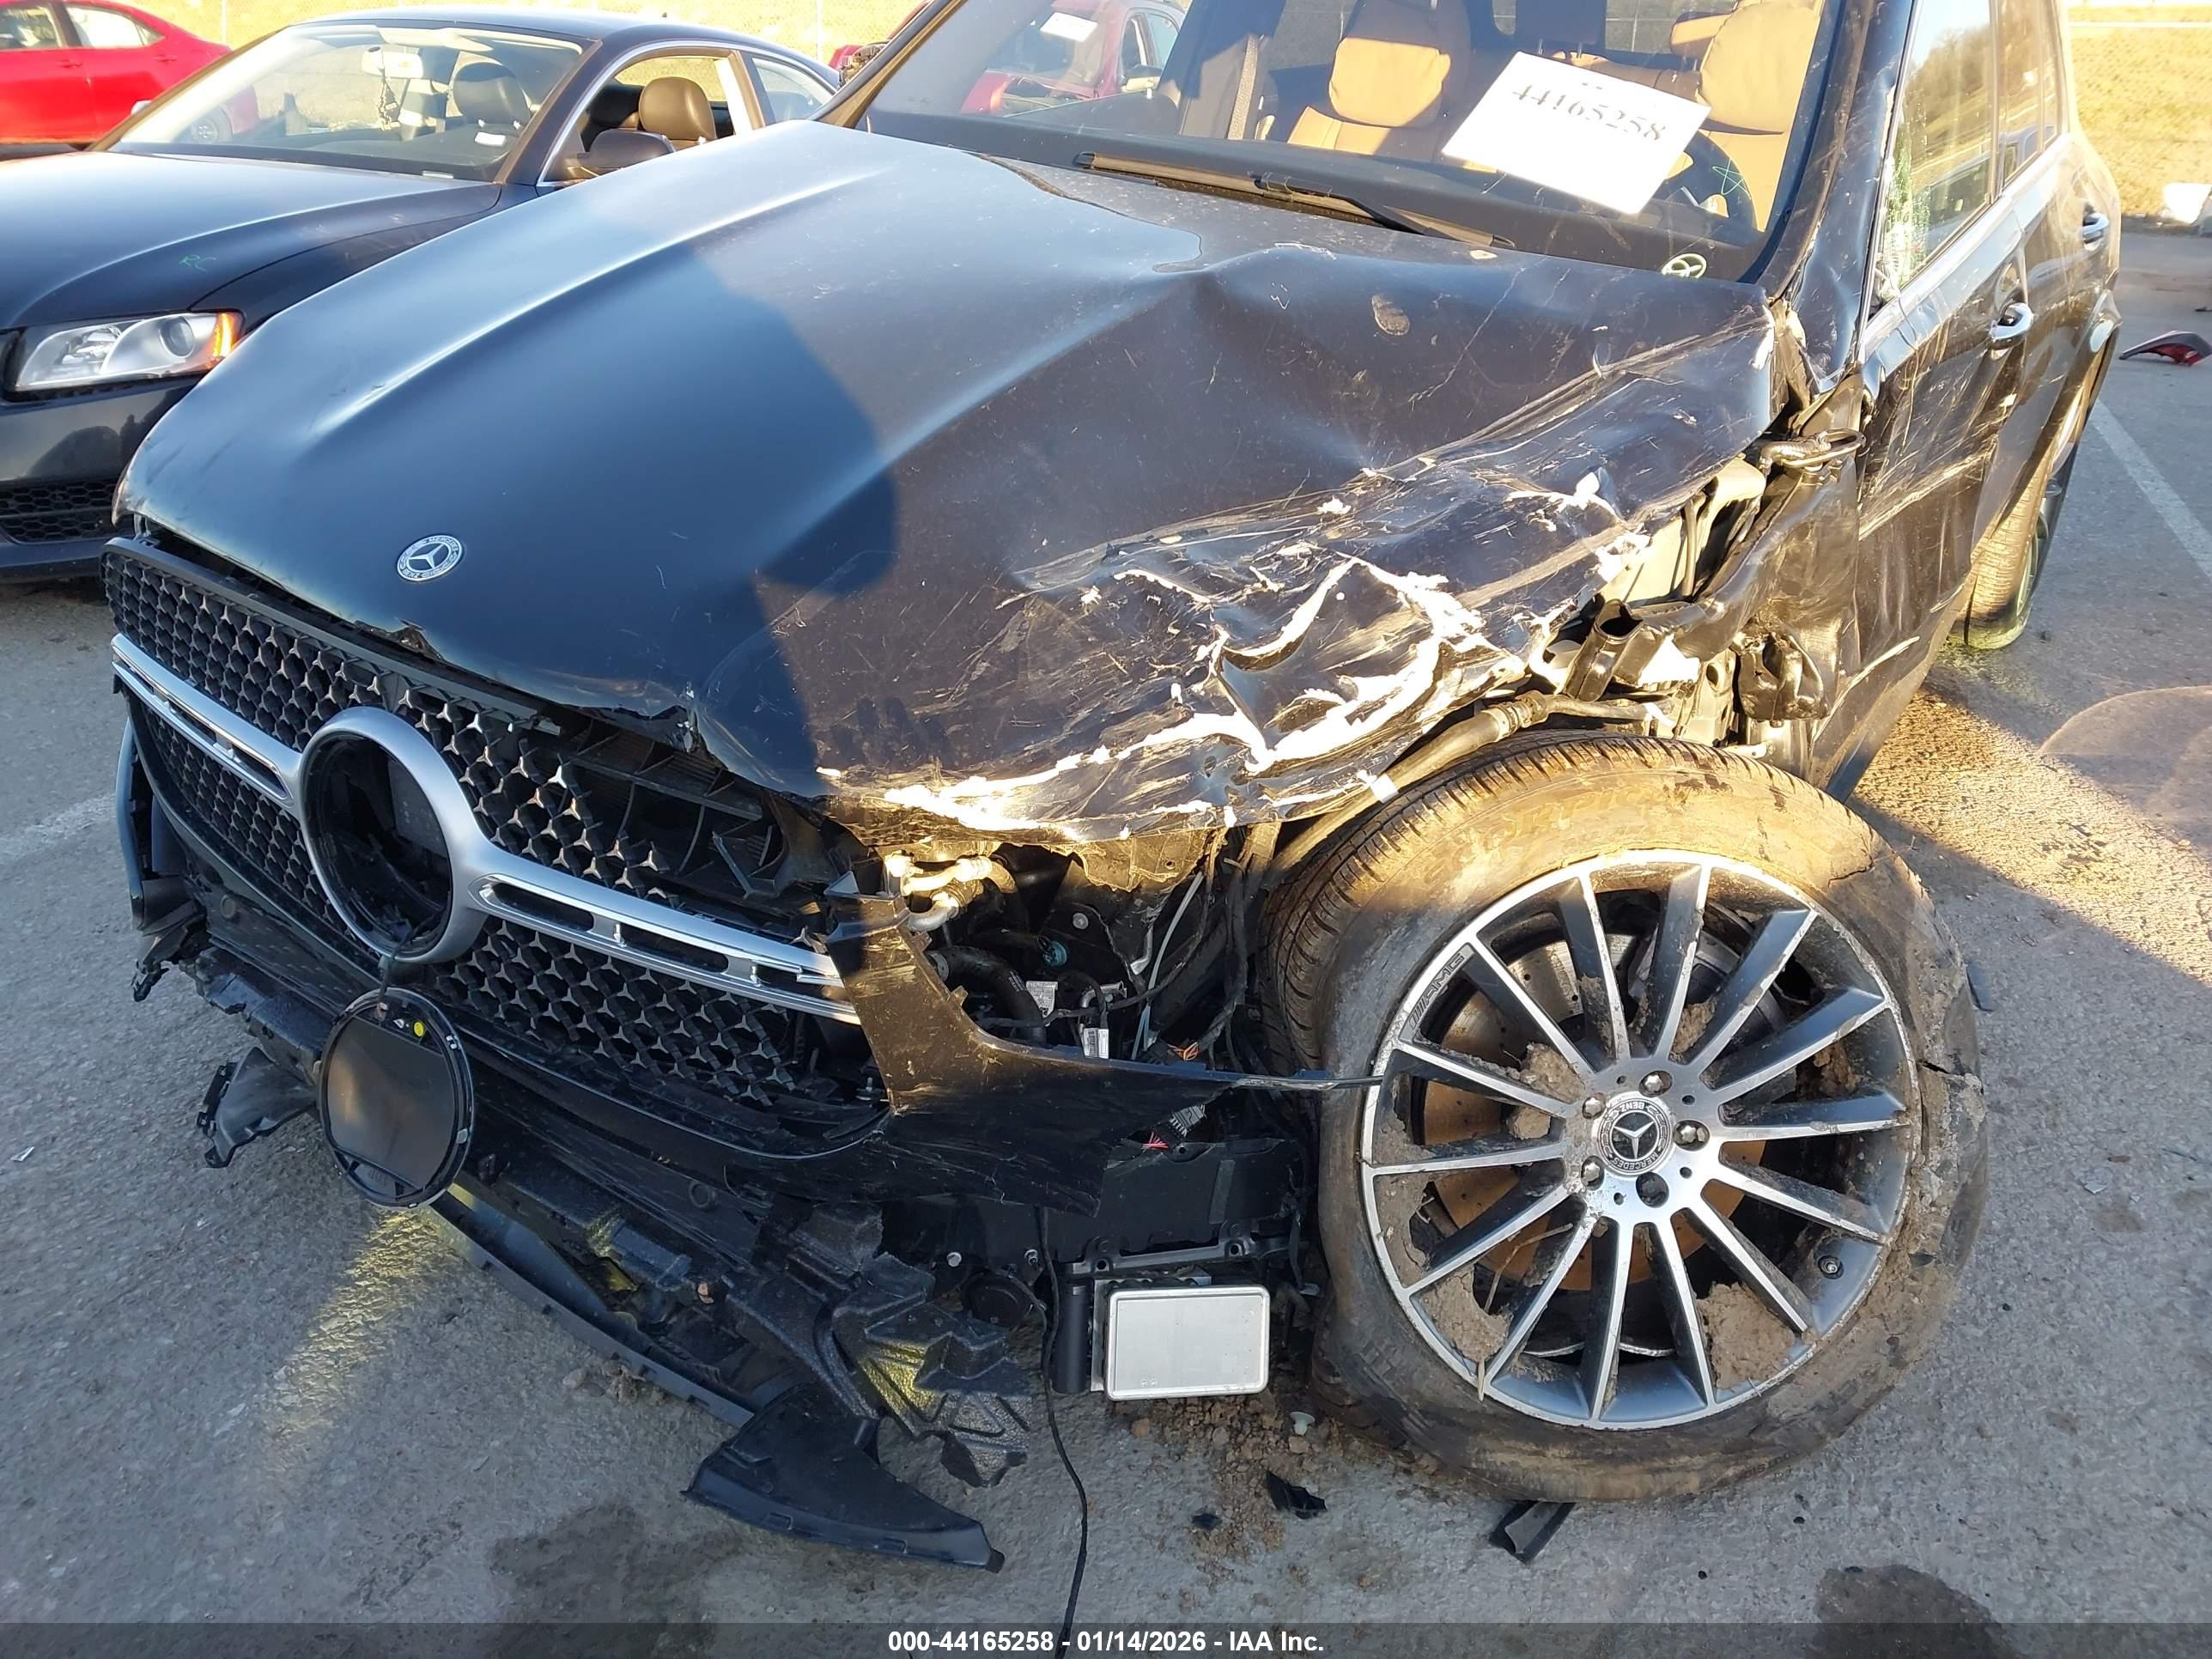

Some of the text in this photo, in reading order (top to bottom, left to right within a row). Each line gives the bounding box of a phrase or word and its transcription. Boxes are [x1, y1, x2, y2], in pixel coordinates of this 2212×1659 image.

[1512, 85, 1667, 142] 44165258
[1620, 1102, 1645, 1113] BENZ
[1613, 1152, 1659, 1170] MERCEDES
